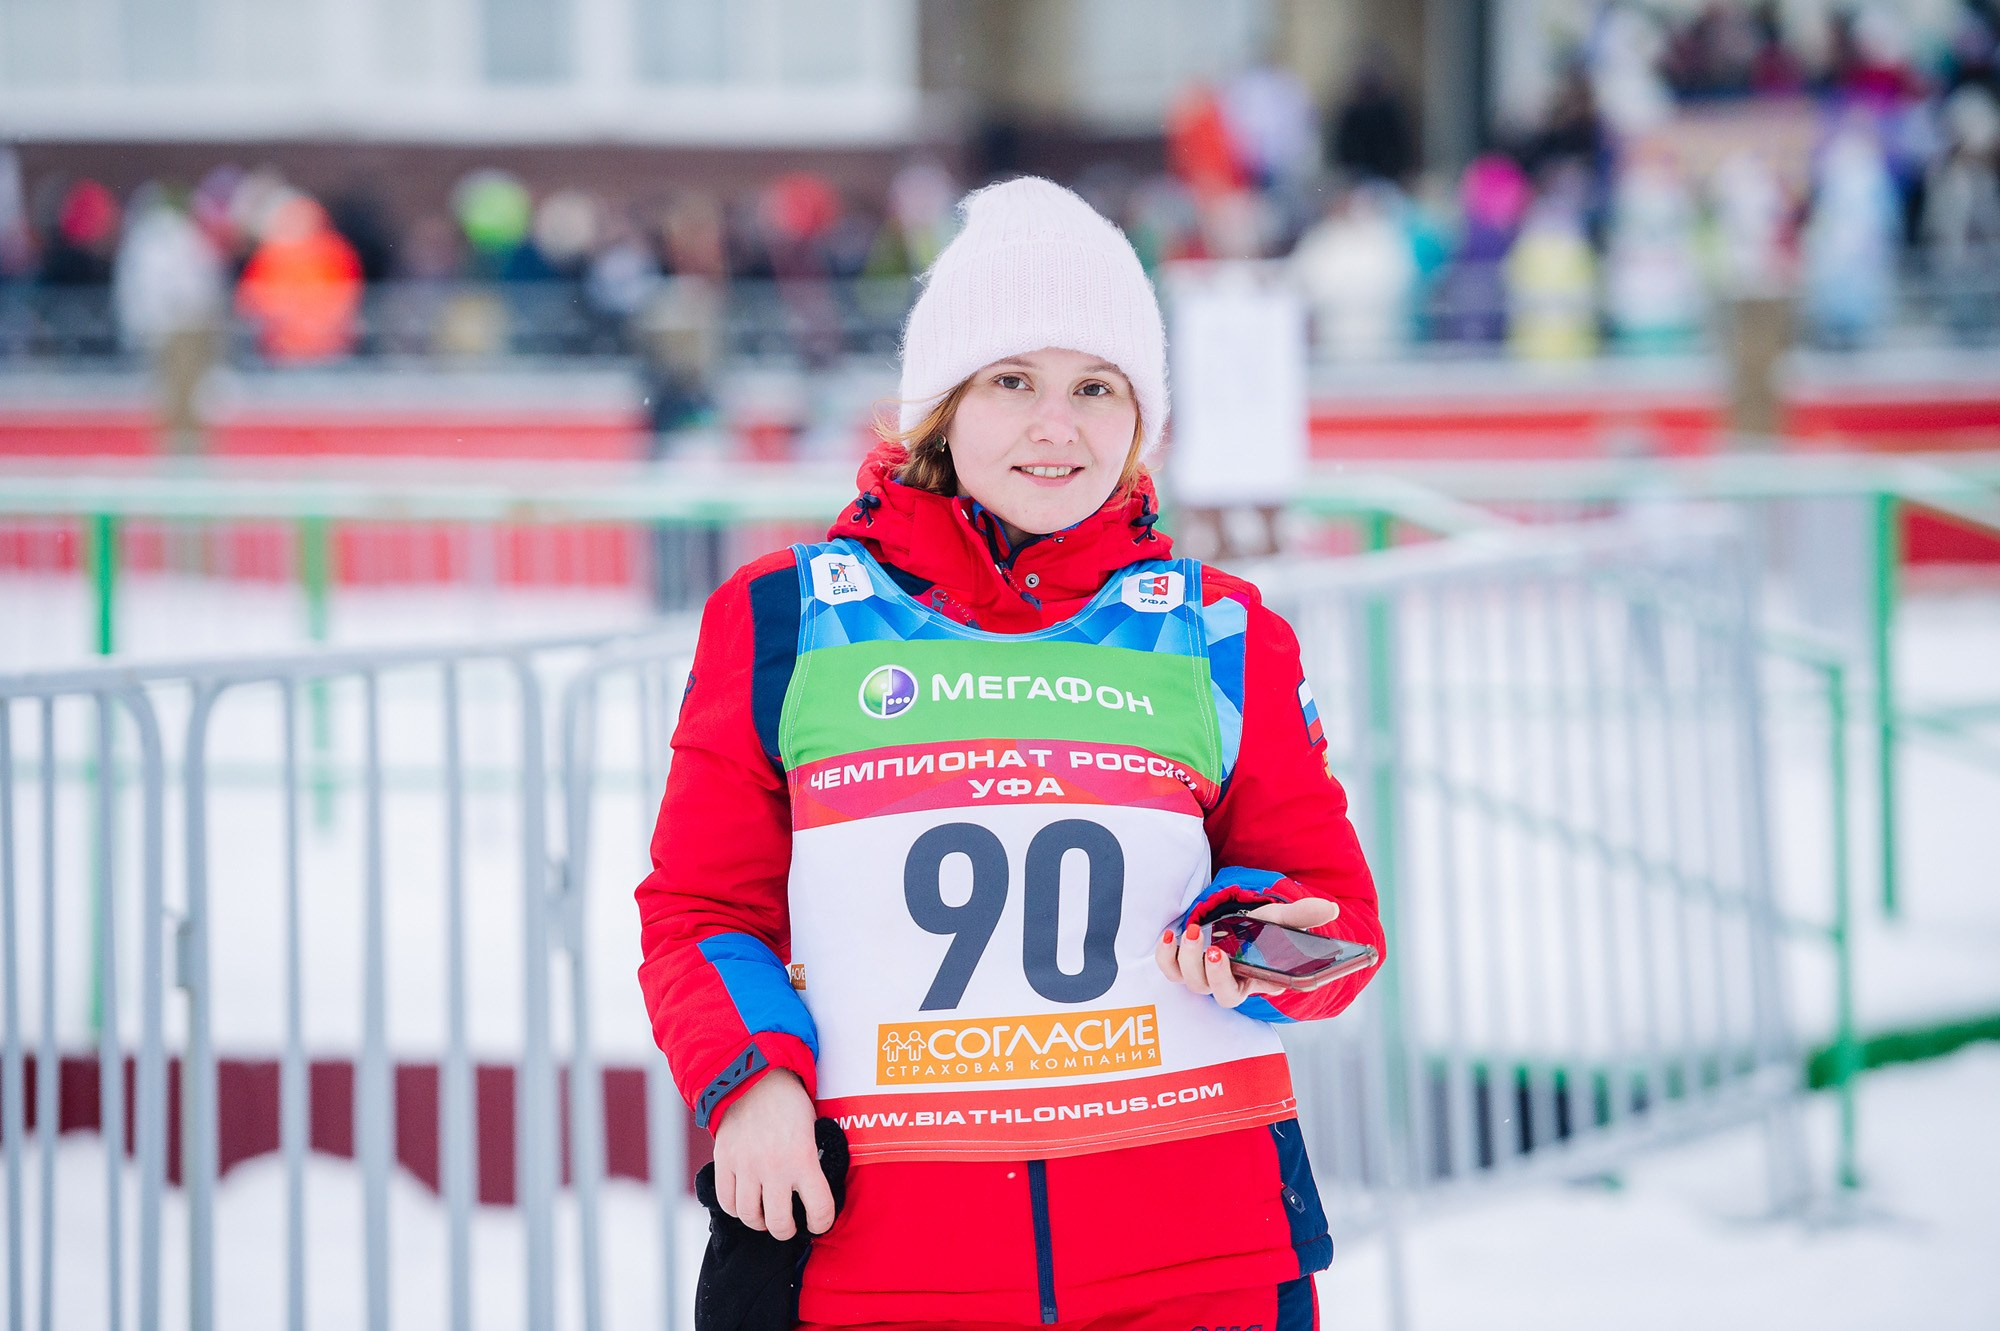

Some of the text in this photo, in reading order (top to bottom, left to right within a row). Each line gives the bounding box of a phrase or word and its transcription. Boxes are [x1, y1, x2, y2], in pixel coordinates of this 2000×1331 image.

[1139, 597, 1169, 605] УФА
[810, 749, 1053, 791] ЧЕМПИОНАТ
[967, 777, 1066, 799] УФА
[903, 818, 1125, 1011] 90
[927, 1013, 1156, 1061] СОГЛАСИЕ
[886, 1048, 1157, 1077] СТРАХОВАЯ КОМПАНИЯ
[834, 1082, 1225, 1130] WWW.BIATHLONRUS.COM
